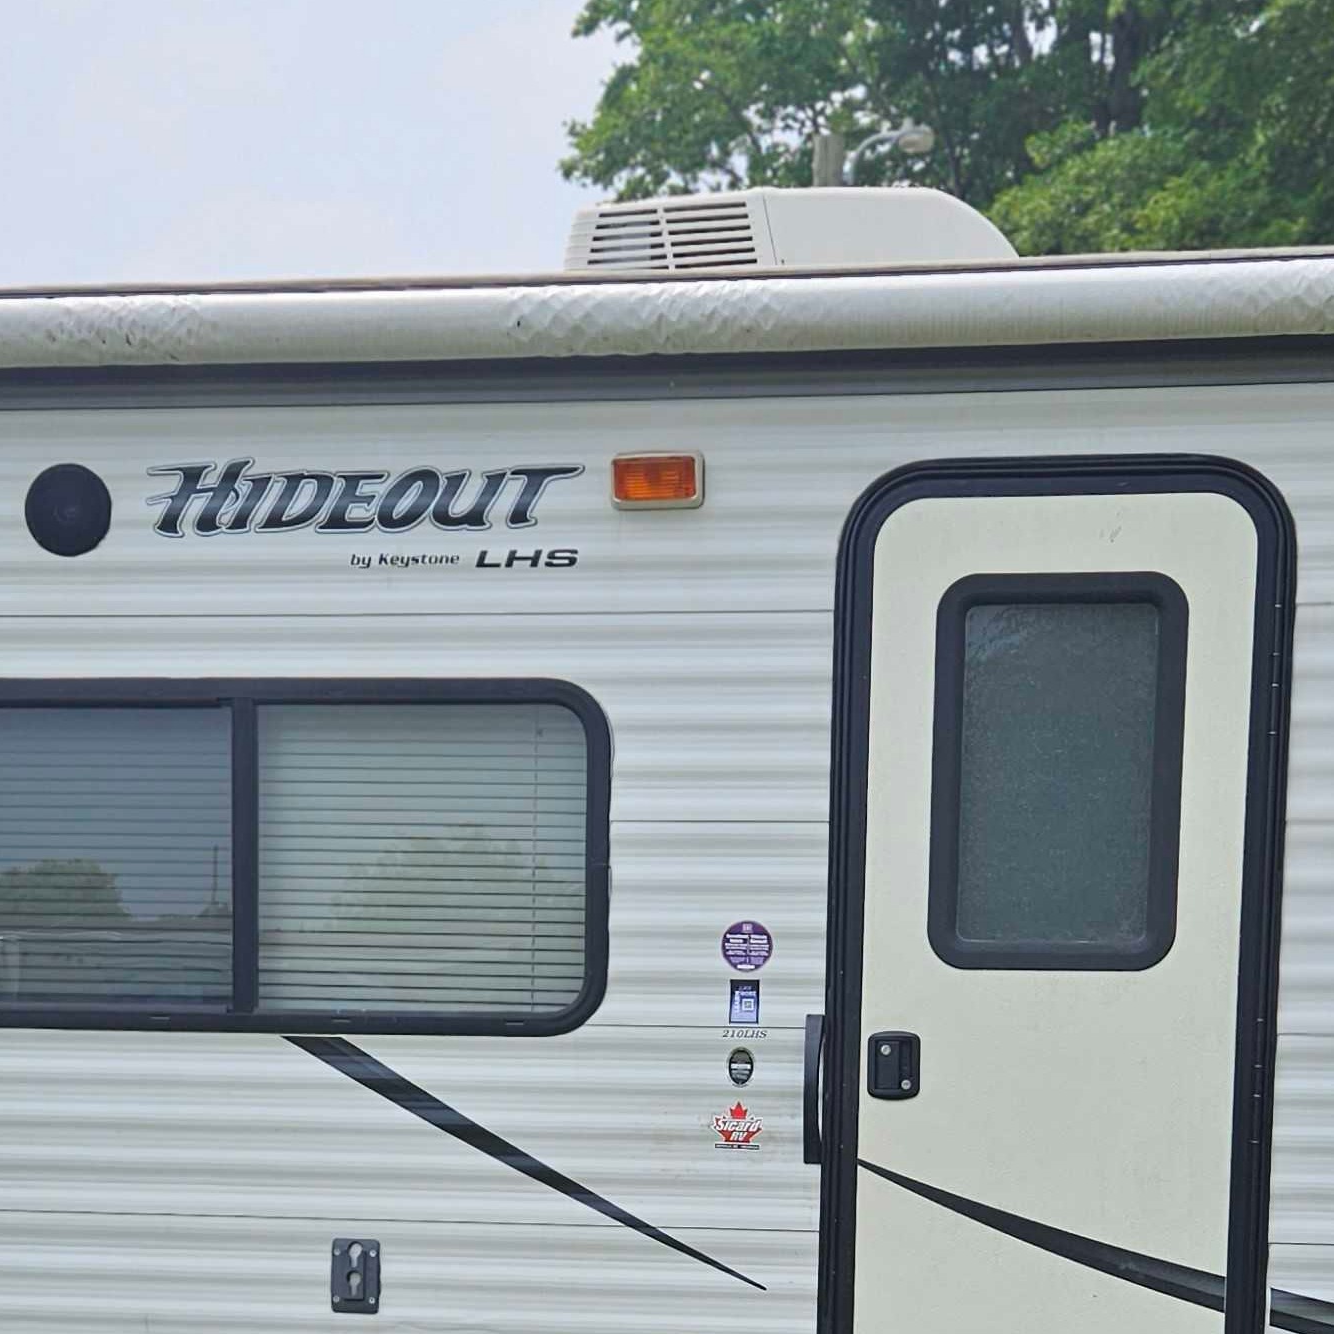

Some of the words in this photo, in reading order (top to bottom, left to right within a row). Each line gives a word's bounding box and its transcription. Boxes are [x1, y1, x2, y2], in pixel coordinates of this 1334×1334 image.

[146, 457, 585, 538] HIDEOUT
[350, 554, 371, 569] by
[378, 553, 460, 568] Keystone
[475, 549, 579, 568] LHS
[722, 1030, 767, 1038] 210LHS
